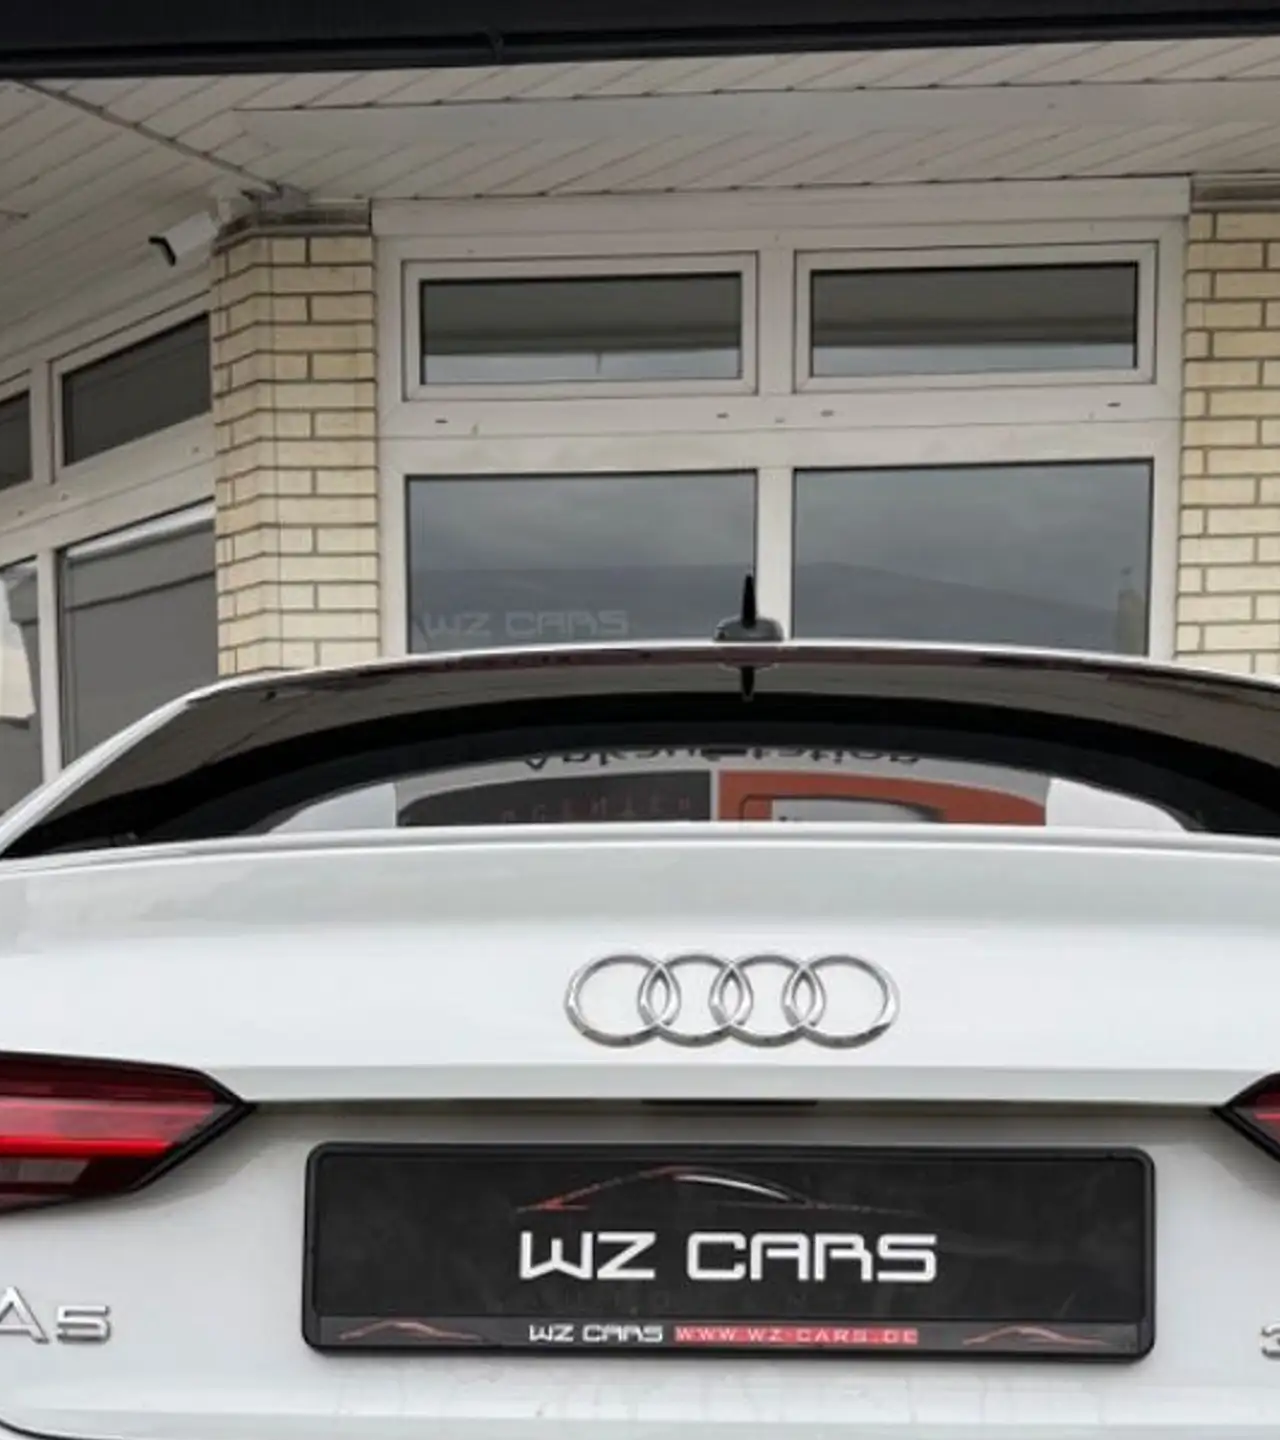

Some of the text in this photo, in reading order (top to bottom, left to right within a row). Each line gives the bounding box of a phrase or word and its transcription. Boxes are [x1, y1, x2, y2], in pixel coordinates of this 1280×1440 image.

[422, 609, 629, 641] WZ CARS
[519, 1230, 939, 1283] WZ CARS
[528, 1324, 574, 1343] WZ
[582, 1323, 664, 1343] CARS
